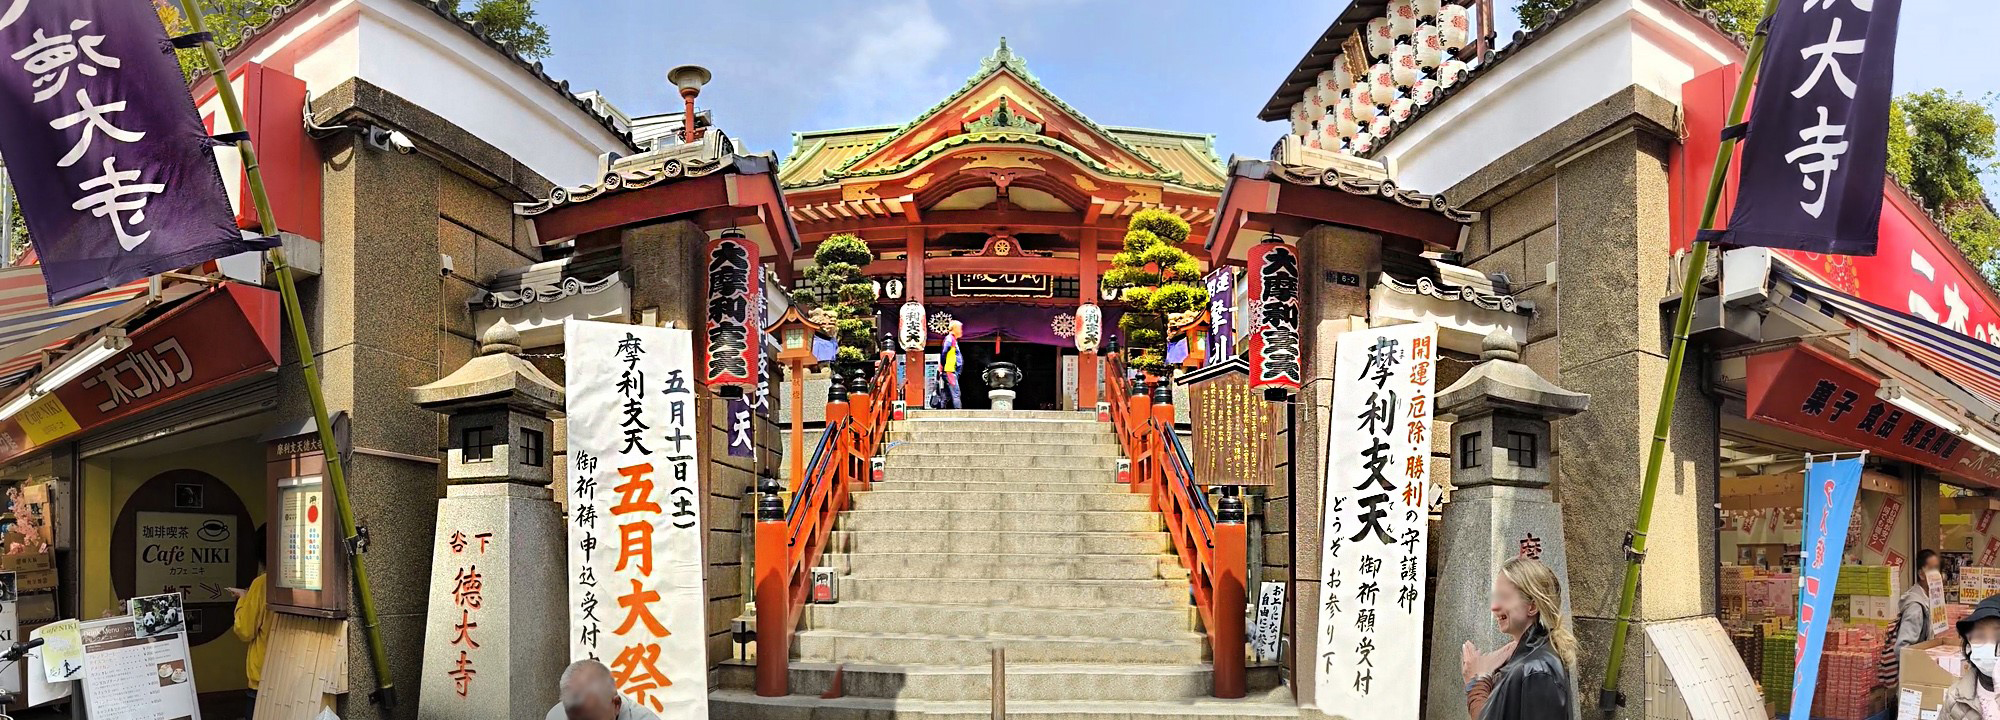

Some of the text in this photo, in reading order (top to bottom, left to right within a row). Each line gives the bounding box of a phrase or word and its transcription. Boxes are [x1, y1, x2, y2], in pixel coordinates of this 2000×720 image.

[708, 241, 749, 378] 大摩利支天
[1262, 247, 1300, 382] 大摩利支天
[1341, 275, 1356, 284] 6-2
[40, 399, 63, 416] NIKI
[615, 333, 652, 455] 摩利支天
[662, 370, 696, 529] 五月十一日(土)
[1349, 336, 1400, 545] 摩利支天
[1802, 379, 1859, 422] 菓子
[1856, 402, 1904, 440] 食品
[142, 525, 189, 538] 珈琲喫茶
[1397, 336, 1431, 614] 開運・厄除・勝利の守護神
[142, 544, 230, 565] Café NIKI
[170, 567, 205, 575] カフェ ニキ
[610, 462, 673, 712] 五月大祭
[58, 623, 78, 632] NIKI
[102, 626, 120, 636] Menu
[448, 565, 483, 697] 徳大寺
[1353, 555, 1382, 695] 御祈願受付
